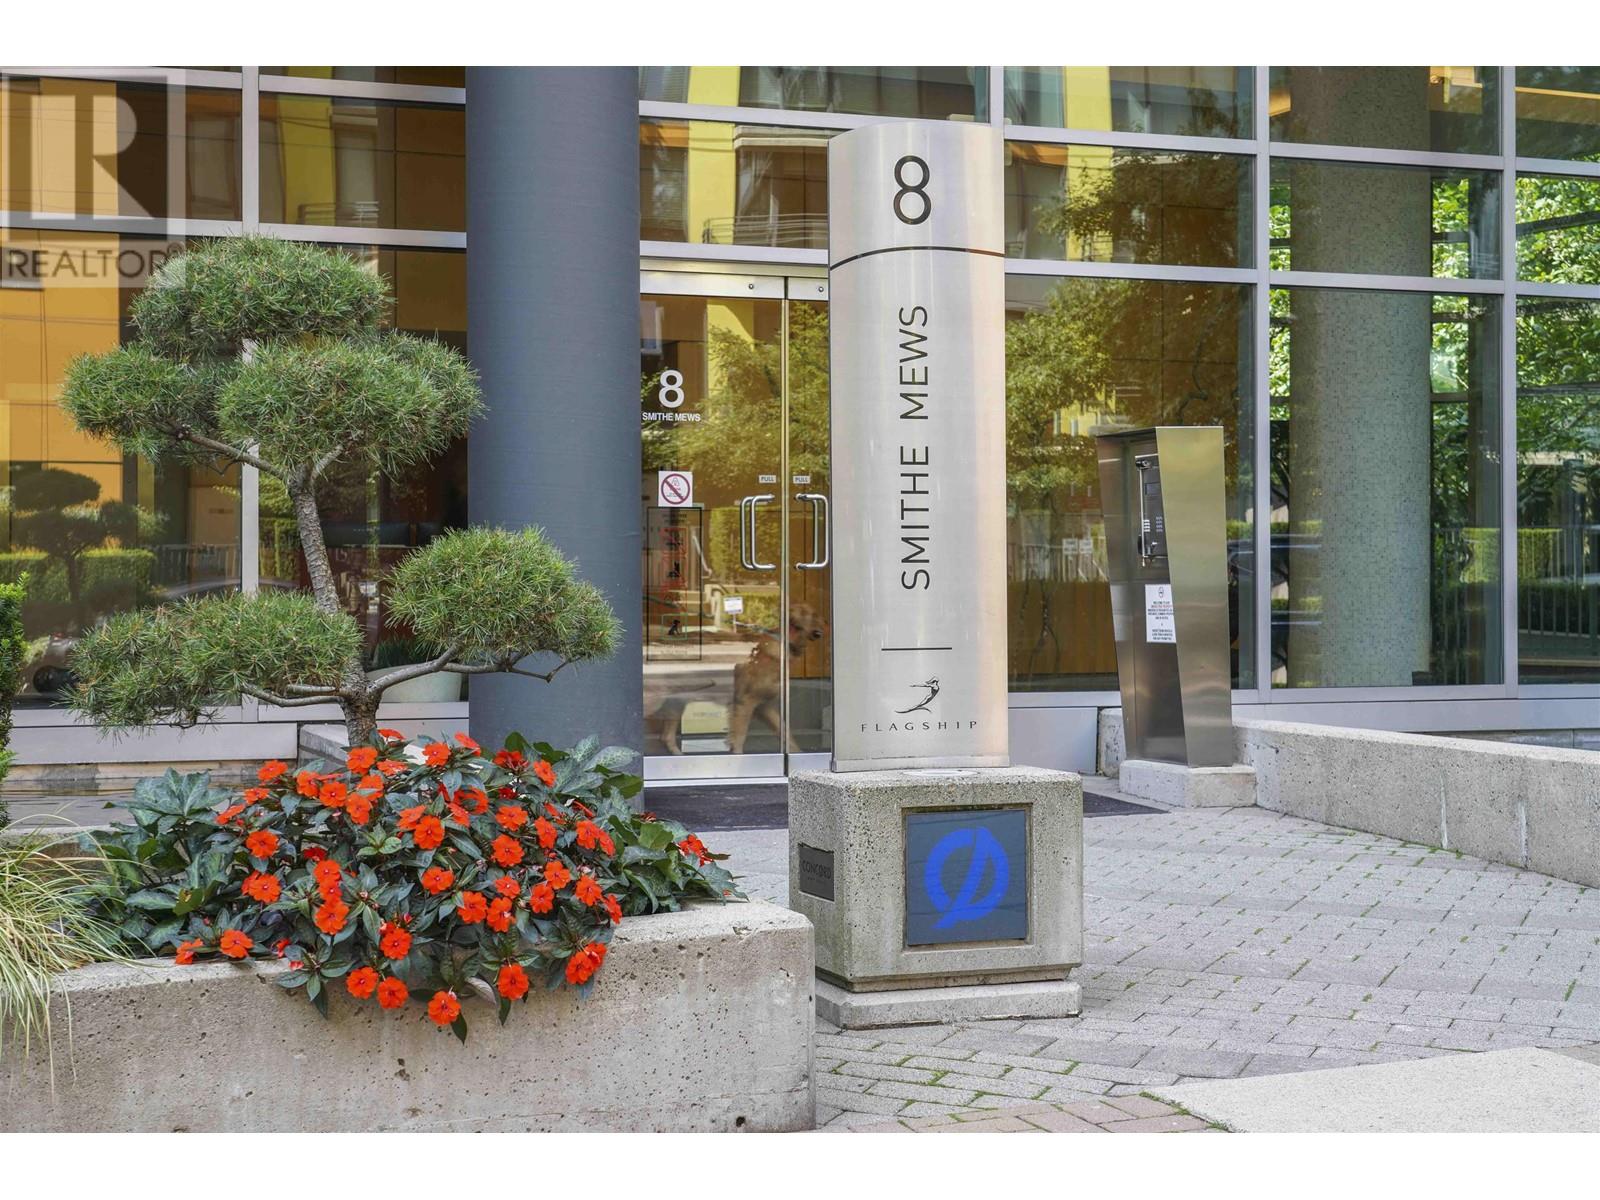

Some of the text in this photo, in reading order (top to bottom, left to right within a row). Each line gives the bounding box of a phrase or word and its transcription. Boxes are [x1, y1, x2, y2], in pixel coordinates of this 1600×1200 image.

[893, 155, 932, 225] 8
[658, 369, 685, 408] 8
[642, 412, 701, 422] SMITHE MEWS
[899, 305, 930, 590] SMITHE MEWS
[861, 720, 977, 733] FLAGSHIP
